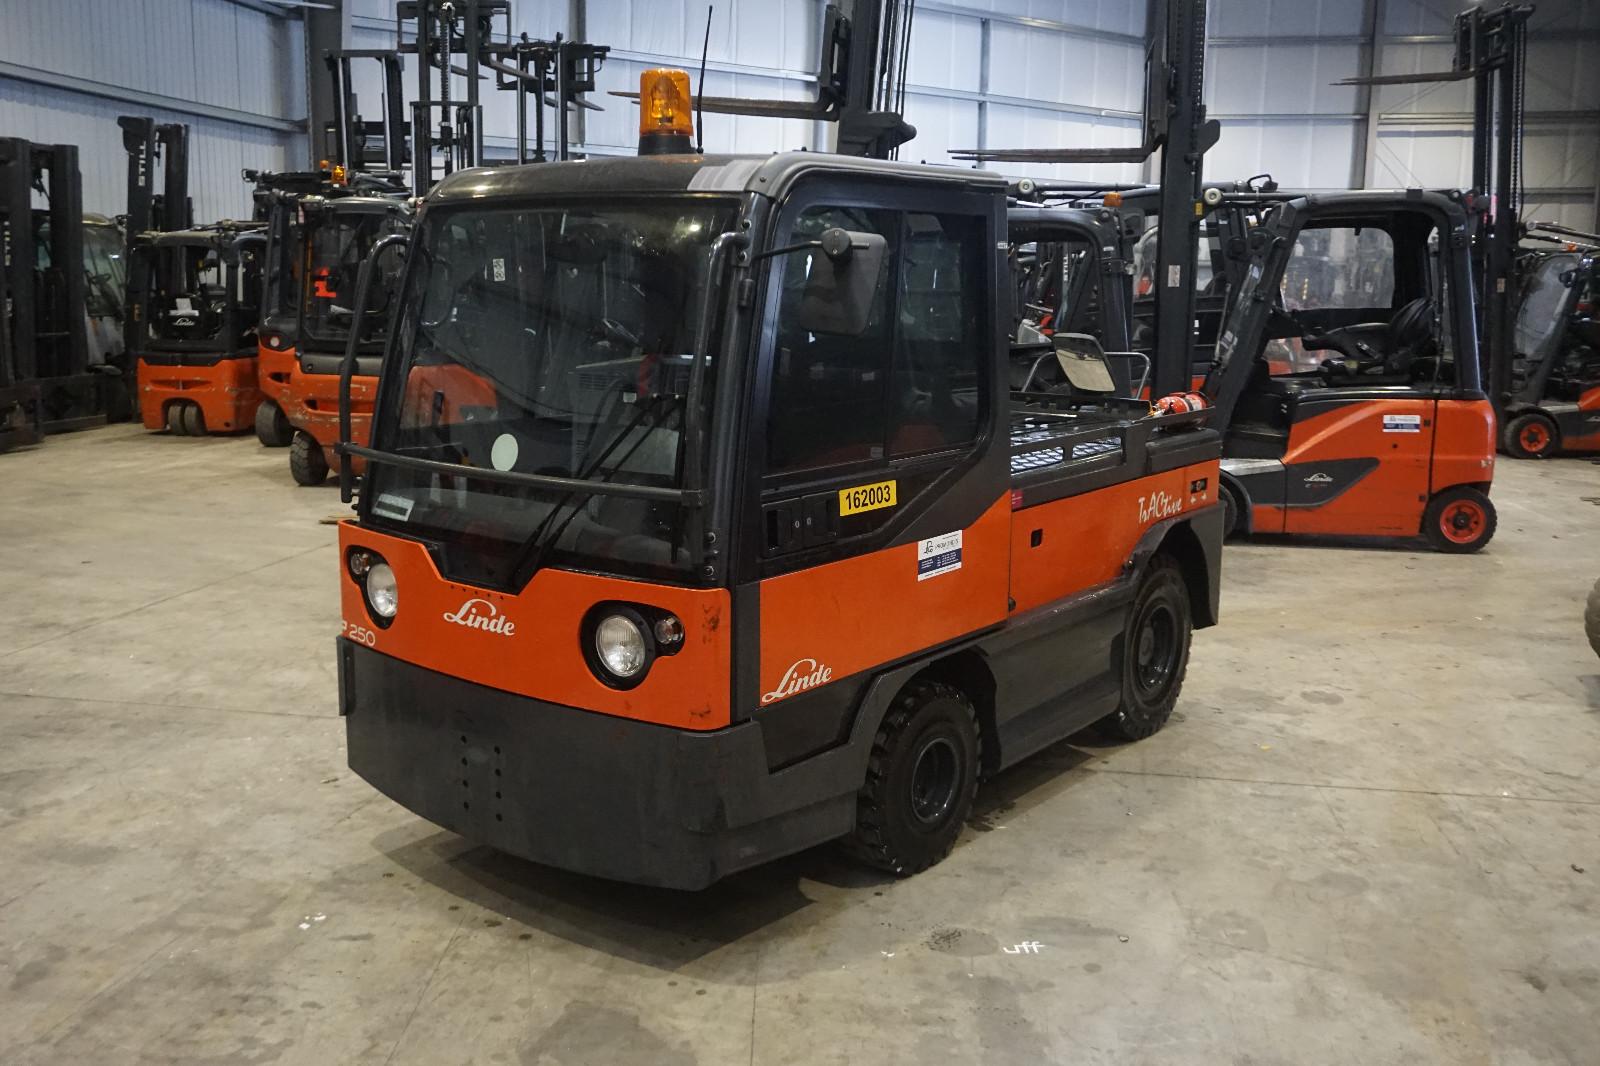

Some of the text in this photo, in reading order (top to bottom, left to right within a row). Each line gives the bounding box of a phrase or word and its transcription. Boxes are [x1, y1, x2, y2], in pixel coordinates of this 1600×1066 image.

[138, 140, 146, 186] STILL
[1303, 472, 1334, 482] Linde
[845, 485, 891, 510] 162003
[443, 598, 515, 636] Linde
[349, 623, 376, 647] 250
[761, 658, 832, 703] Linde
